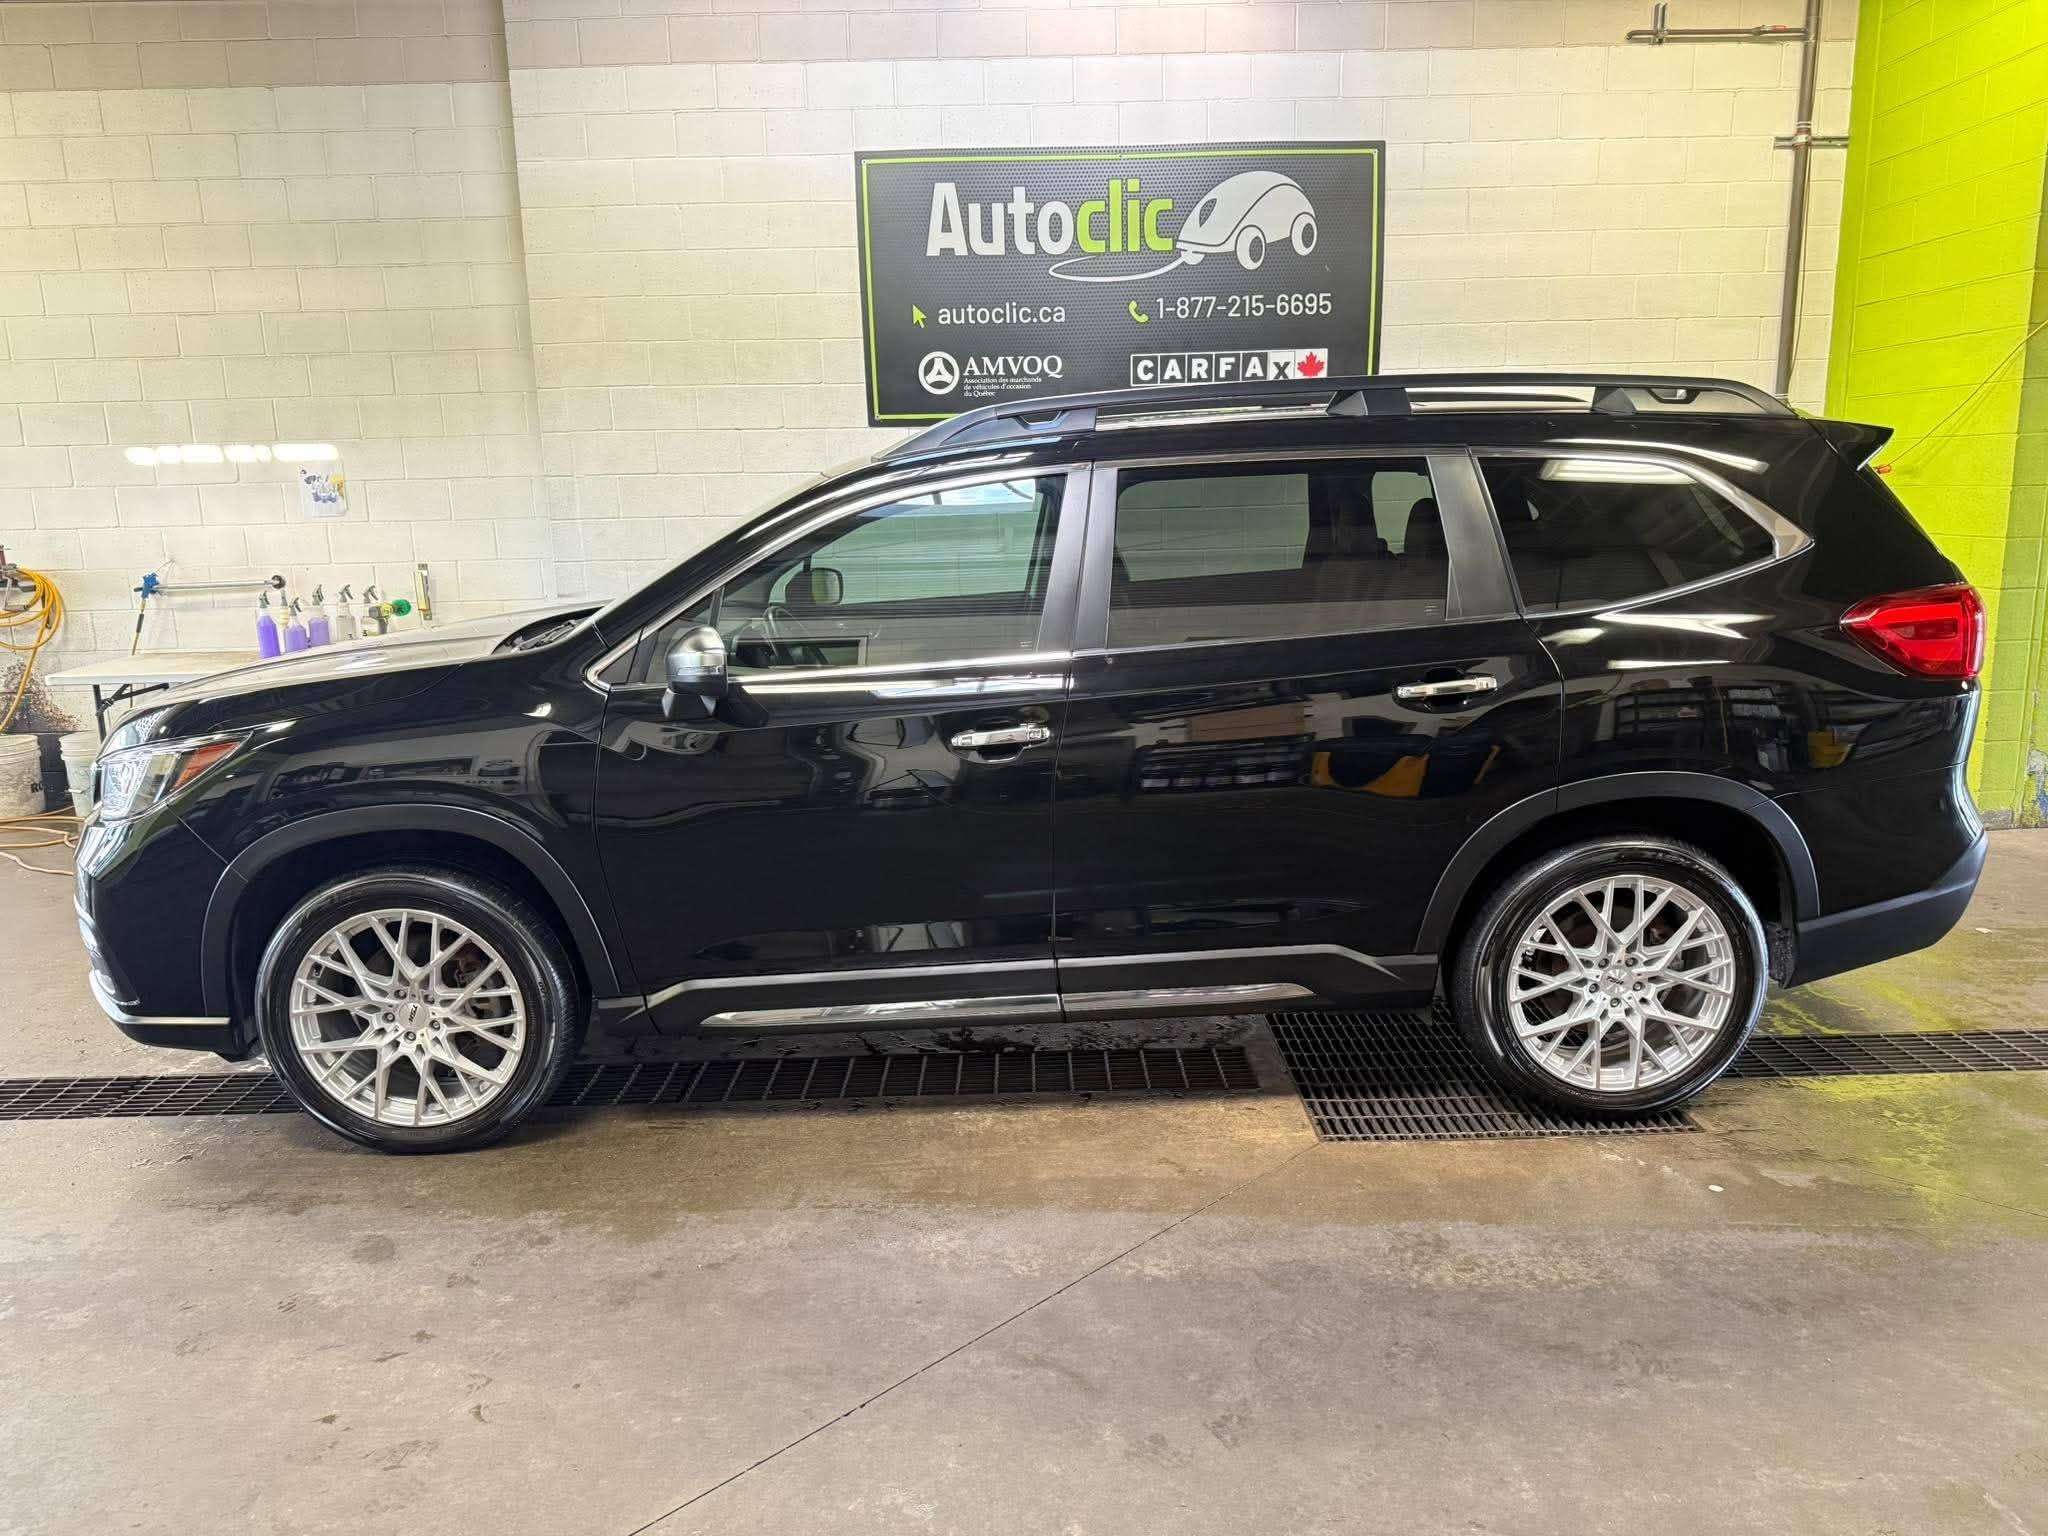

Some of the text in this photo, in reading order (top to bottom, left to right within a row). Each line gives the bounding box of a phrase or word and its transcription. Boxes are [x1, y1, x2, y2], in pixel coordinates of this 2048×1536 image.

[926, 178, 1174, 257] Autoclic
[937, 302, 1066, 326] autoclic.ca
[1155, 293, 1333, 319] 1-877-215-6695
[963, 355, 1063, 378] AMVOQ
[1136, 356, 1291, 382] CARFAX
